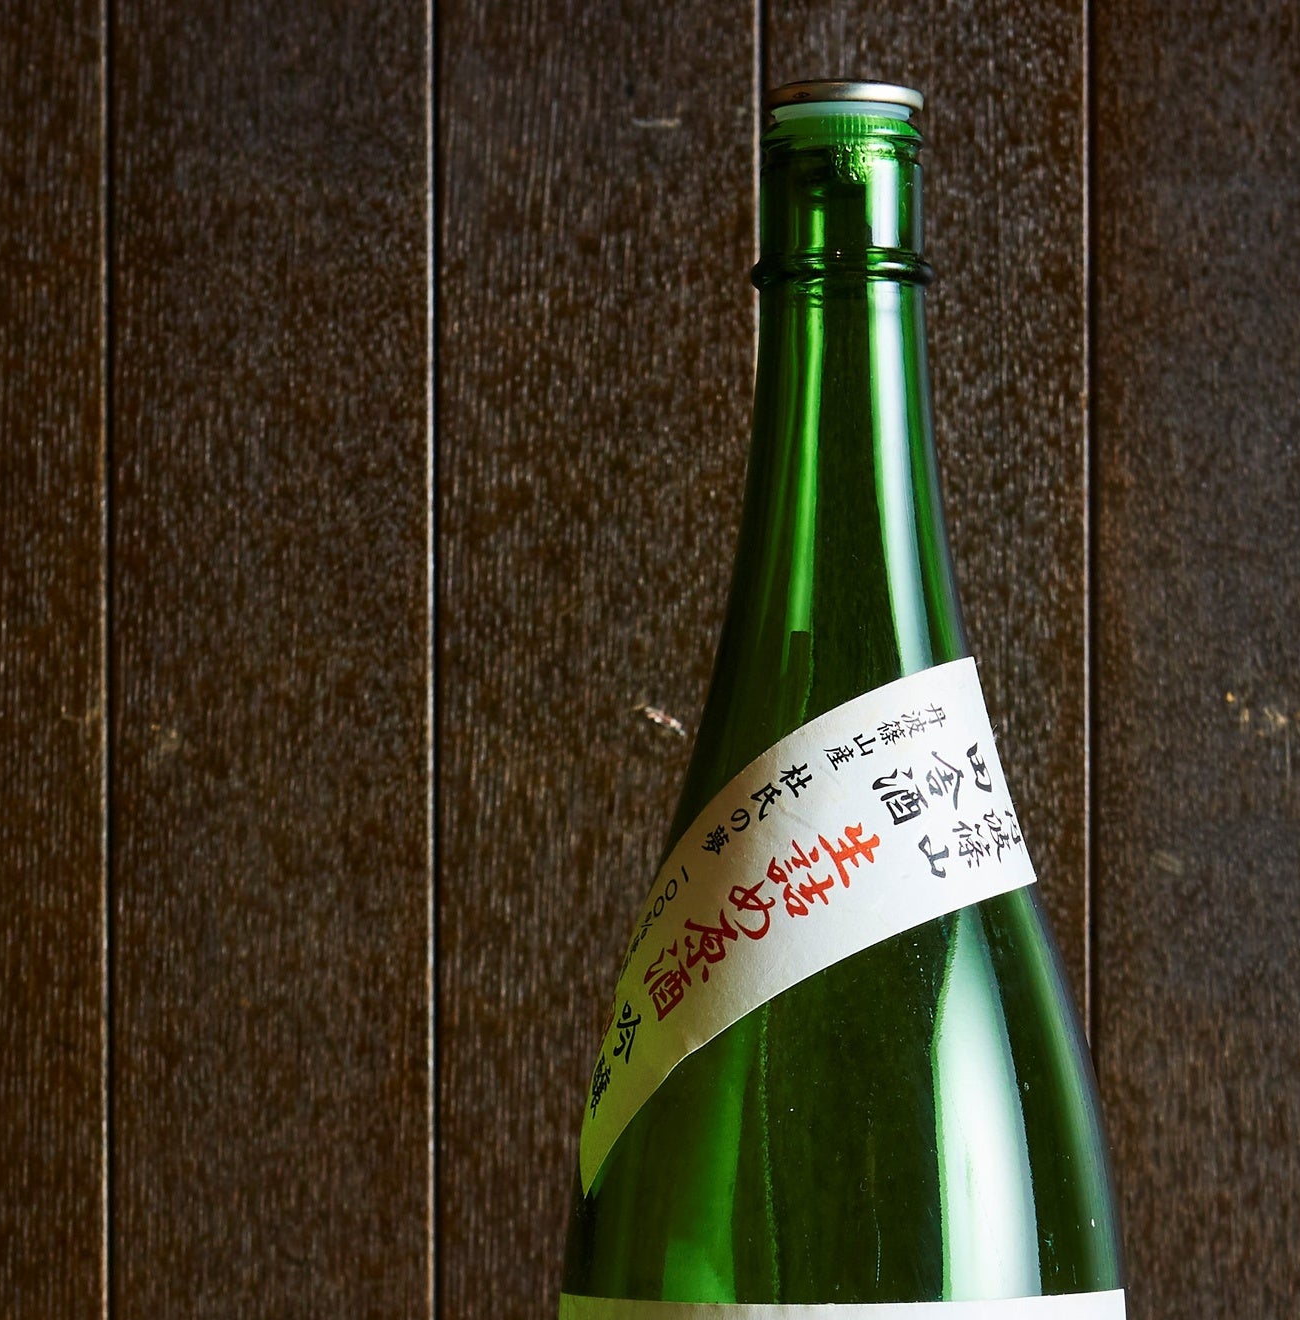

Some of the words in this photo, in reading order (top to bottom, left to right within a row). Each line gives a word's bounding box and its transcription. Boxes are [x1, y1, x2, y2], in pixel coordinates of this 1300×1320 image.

[823, 702, 948, 771] 丹波篠山産
[701, 763, 810, 857] 杜氏の夢
[871, 742, 993, 826] 田舎酒
[642, 821, 882, 1022] 生詰め原酒
